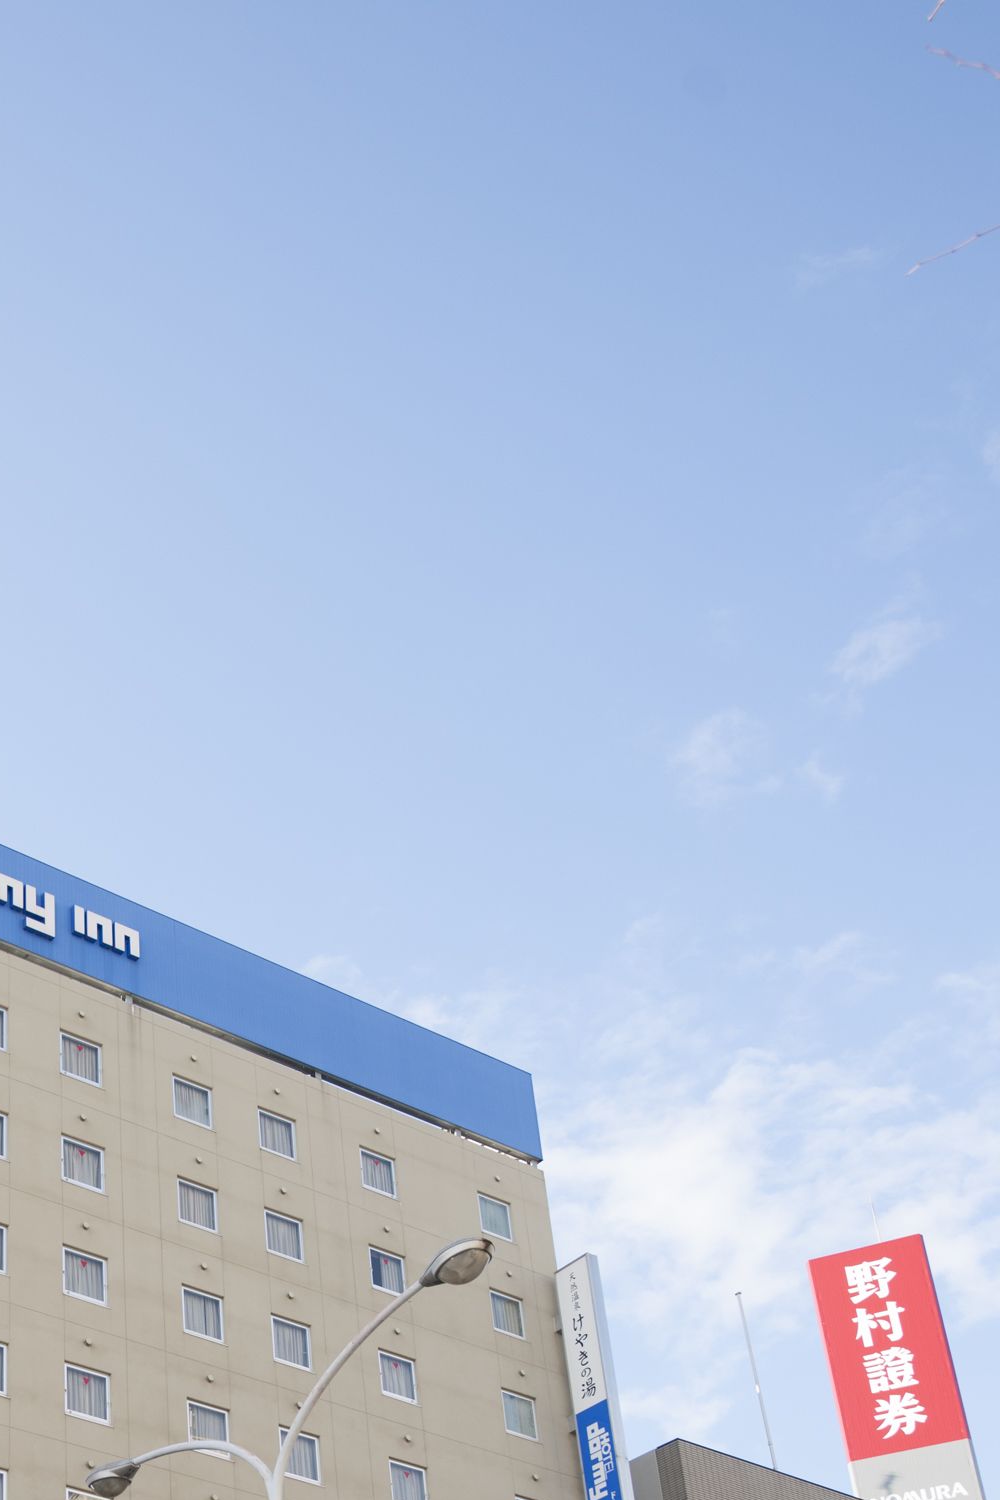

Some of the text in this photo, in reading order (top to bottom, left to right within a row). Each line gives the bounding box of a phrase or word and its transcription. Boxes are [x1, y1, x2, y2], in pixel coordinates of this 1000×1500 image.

[74, 905, 140, 958] inn
[572, 1313, 597, 1400] けやきの湯
[844, 1257, 928, 1440] 野村證券
[600, 1431, 615, 1480] HOTEL
